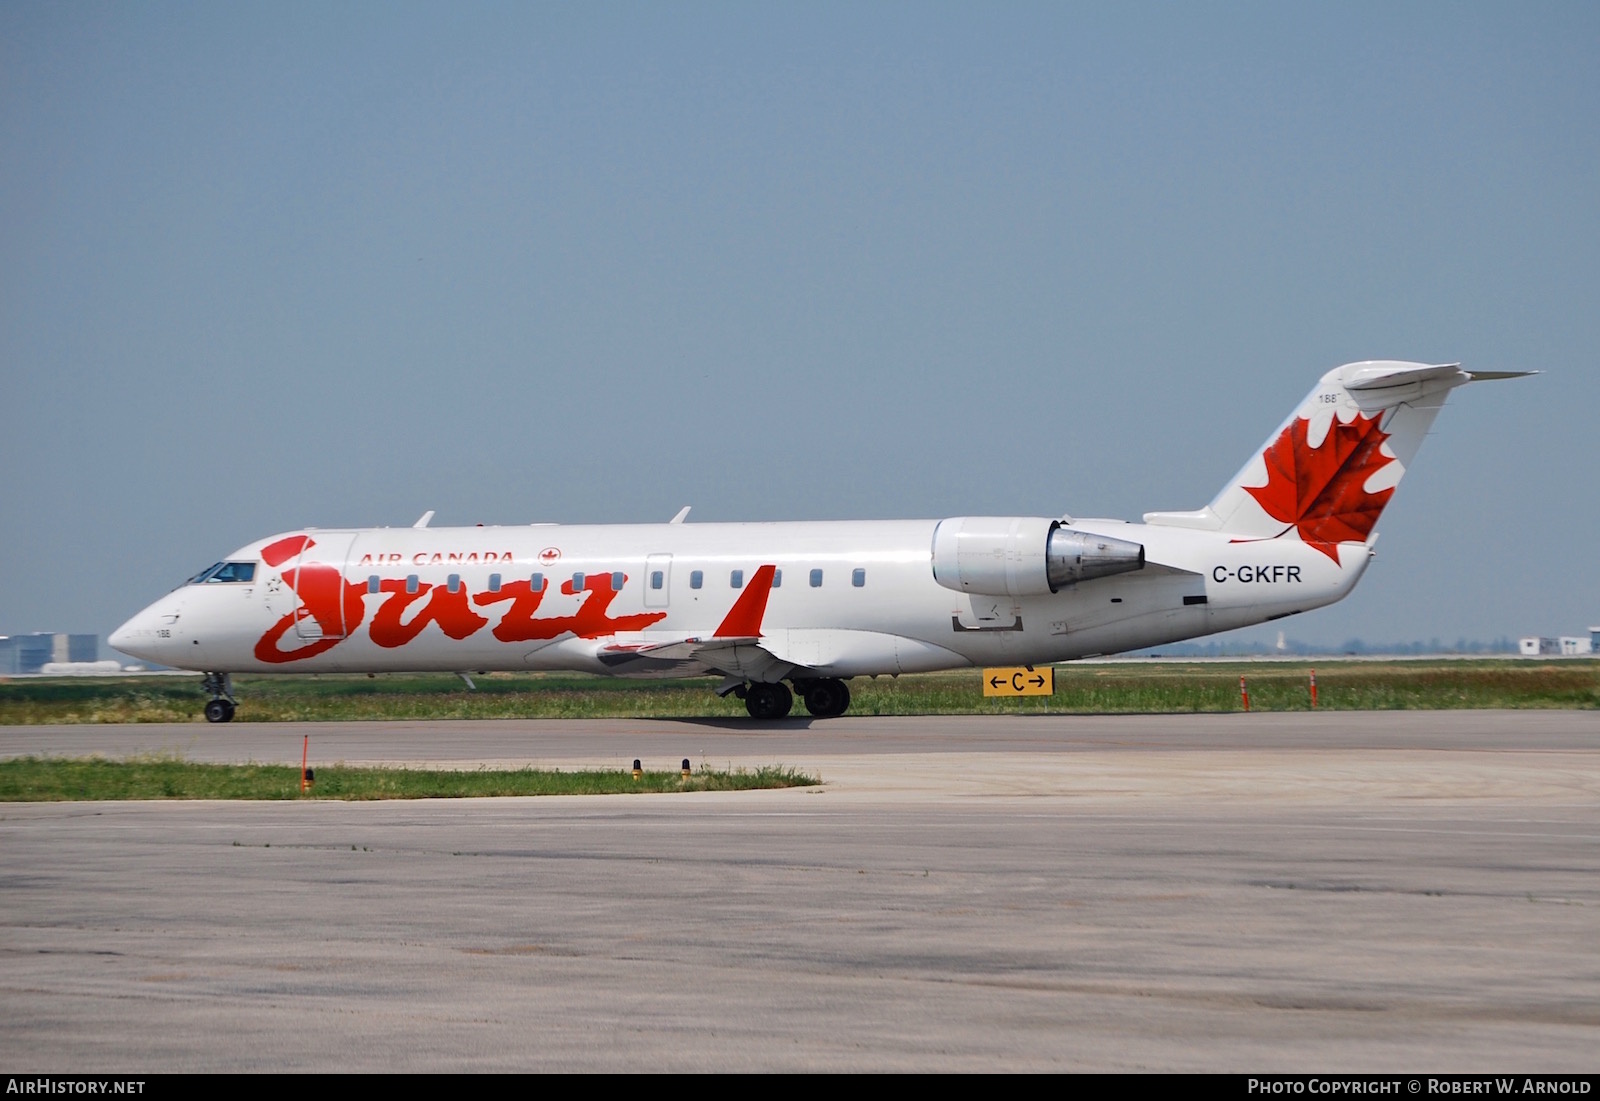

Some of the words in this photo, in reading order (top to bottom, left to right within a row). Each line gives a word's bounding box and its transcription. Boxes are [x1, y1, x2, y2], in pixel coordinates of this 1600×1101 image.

[358, 552, 403, 567] AIR
[412, 551, 514, 566] CANADA
[1212, 565, 1302, 583] C-GKFR
[1012, 672, 1025, 692] C
